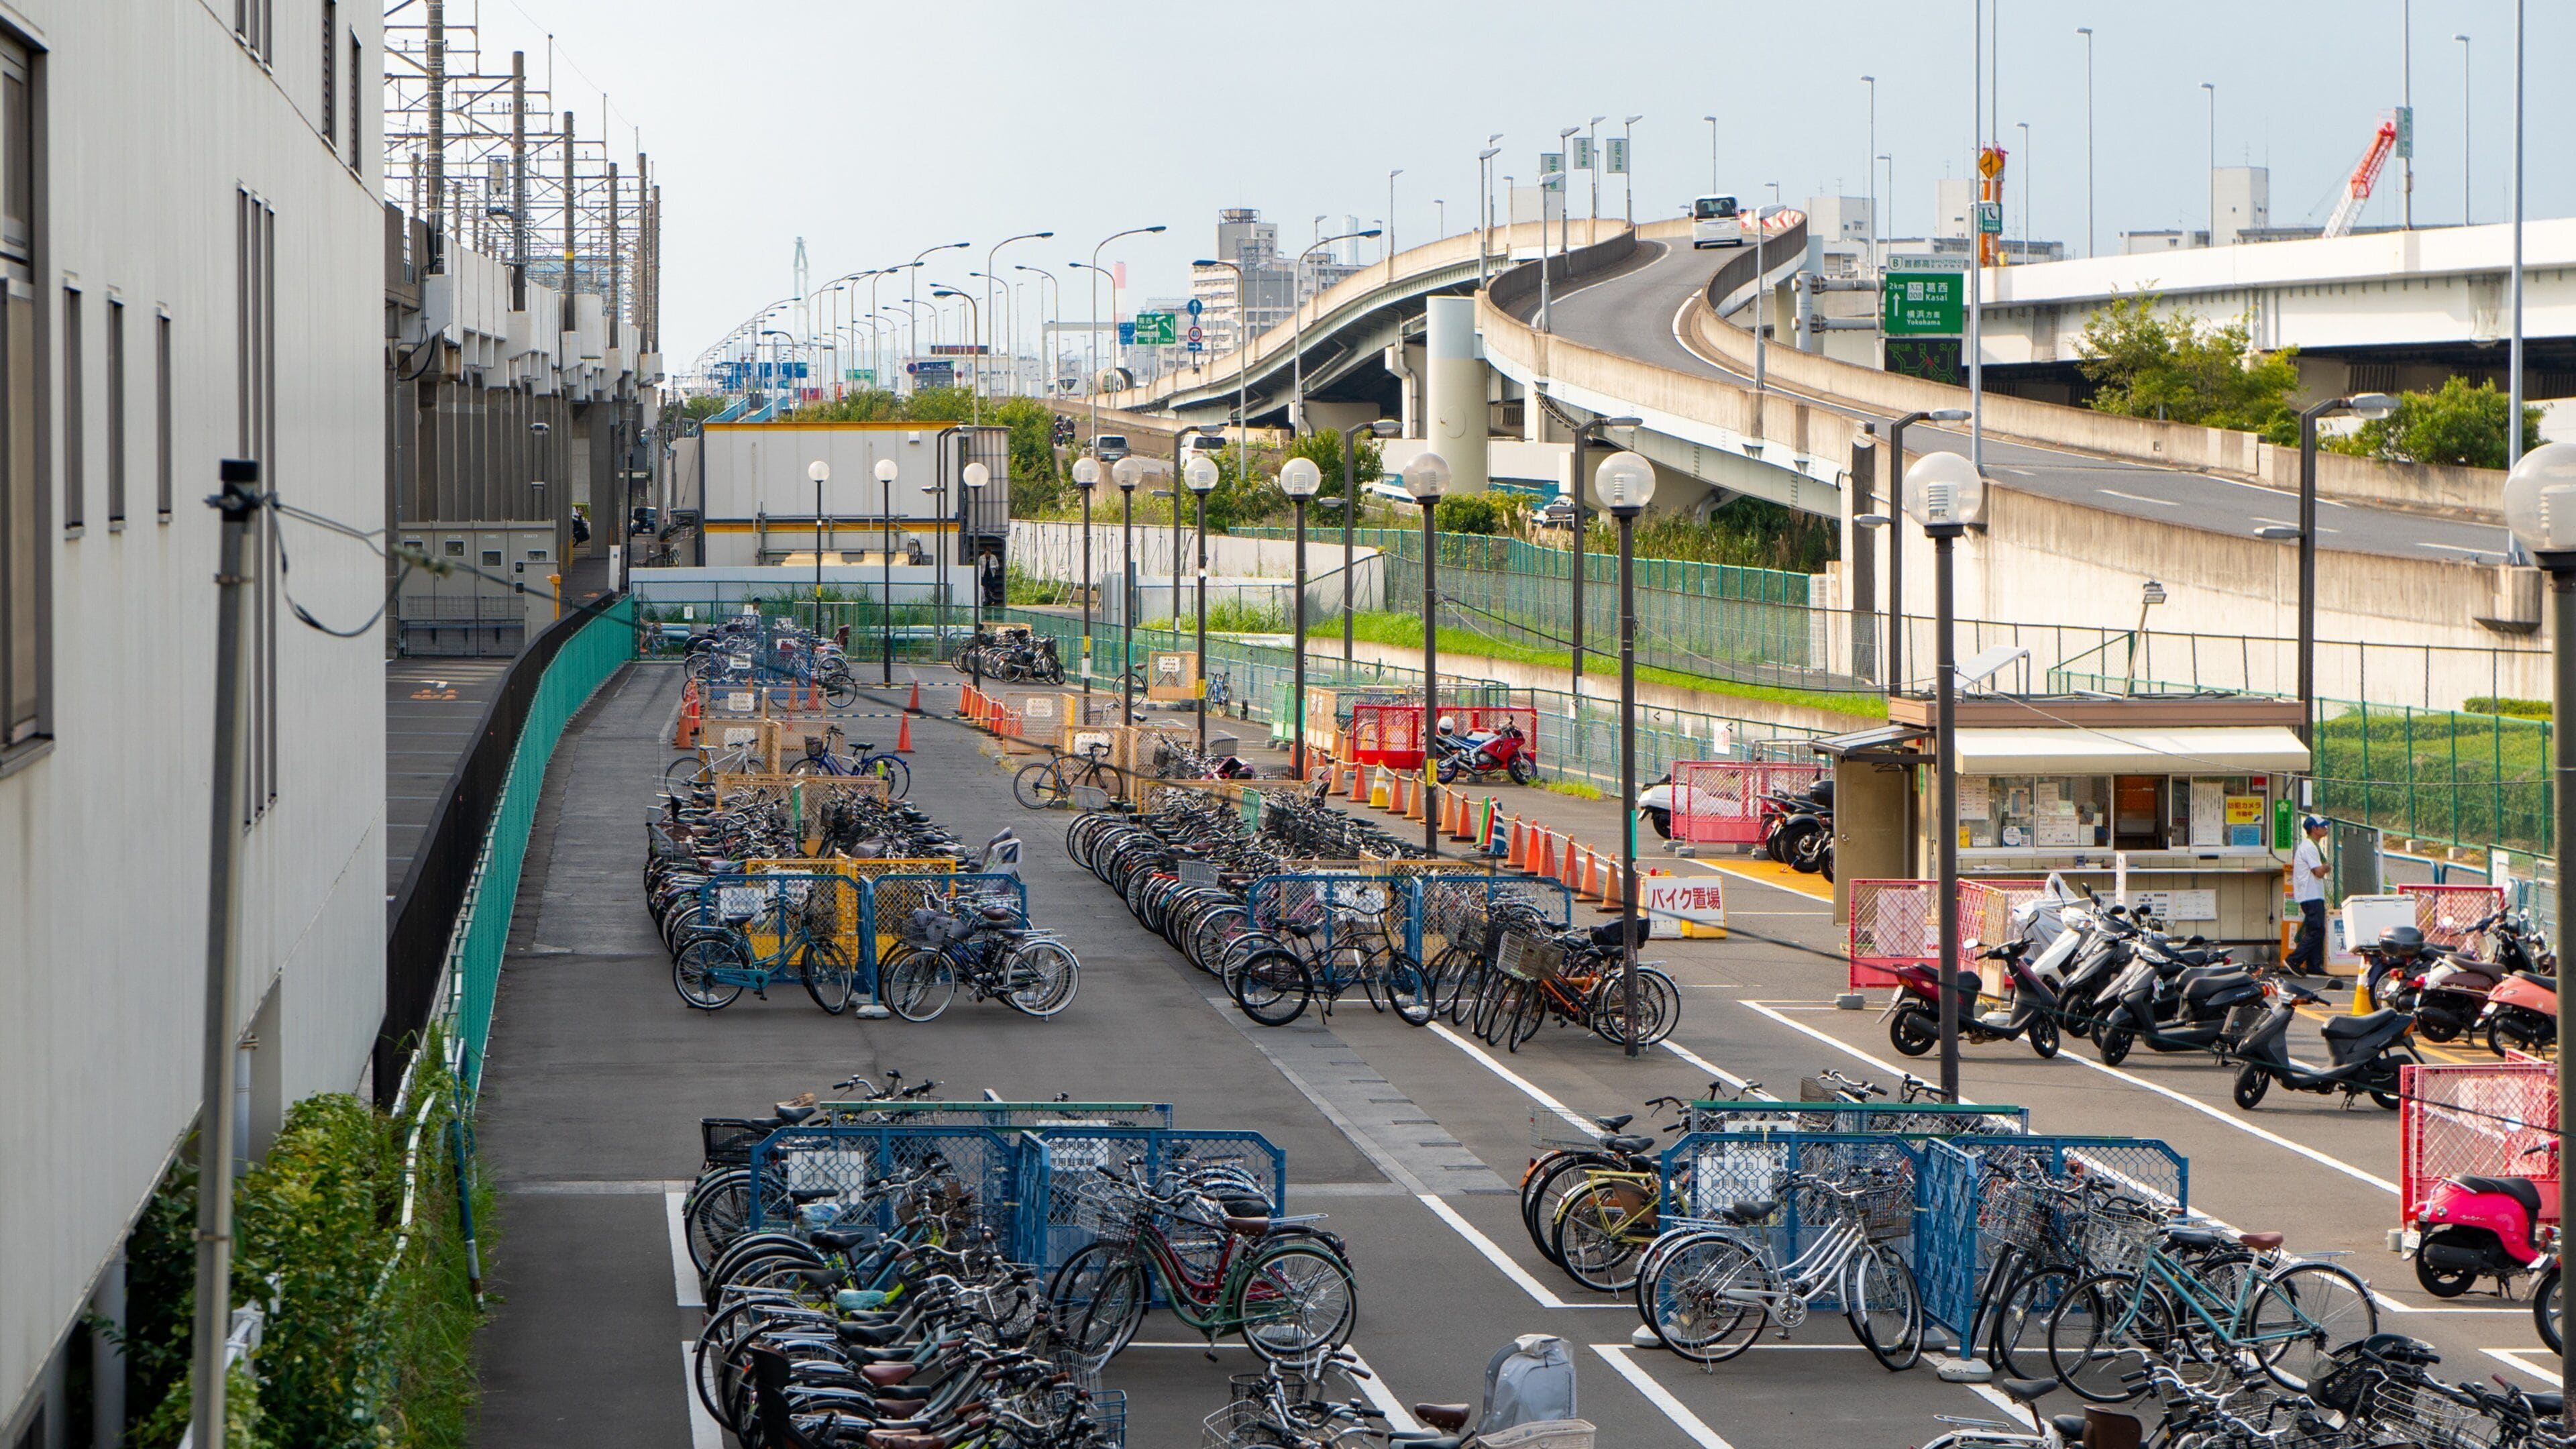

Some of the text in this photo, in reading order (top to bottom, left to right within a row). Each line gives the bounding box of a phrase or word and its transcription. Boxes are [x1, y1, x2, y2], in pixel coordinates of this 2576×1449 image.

[1926, 282, 1948, 292] 葛西
[1907, 310, 1940, 319] 横浜方面
[1651, 887, 1721, 910] バイク置場
